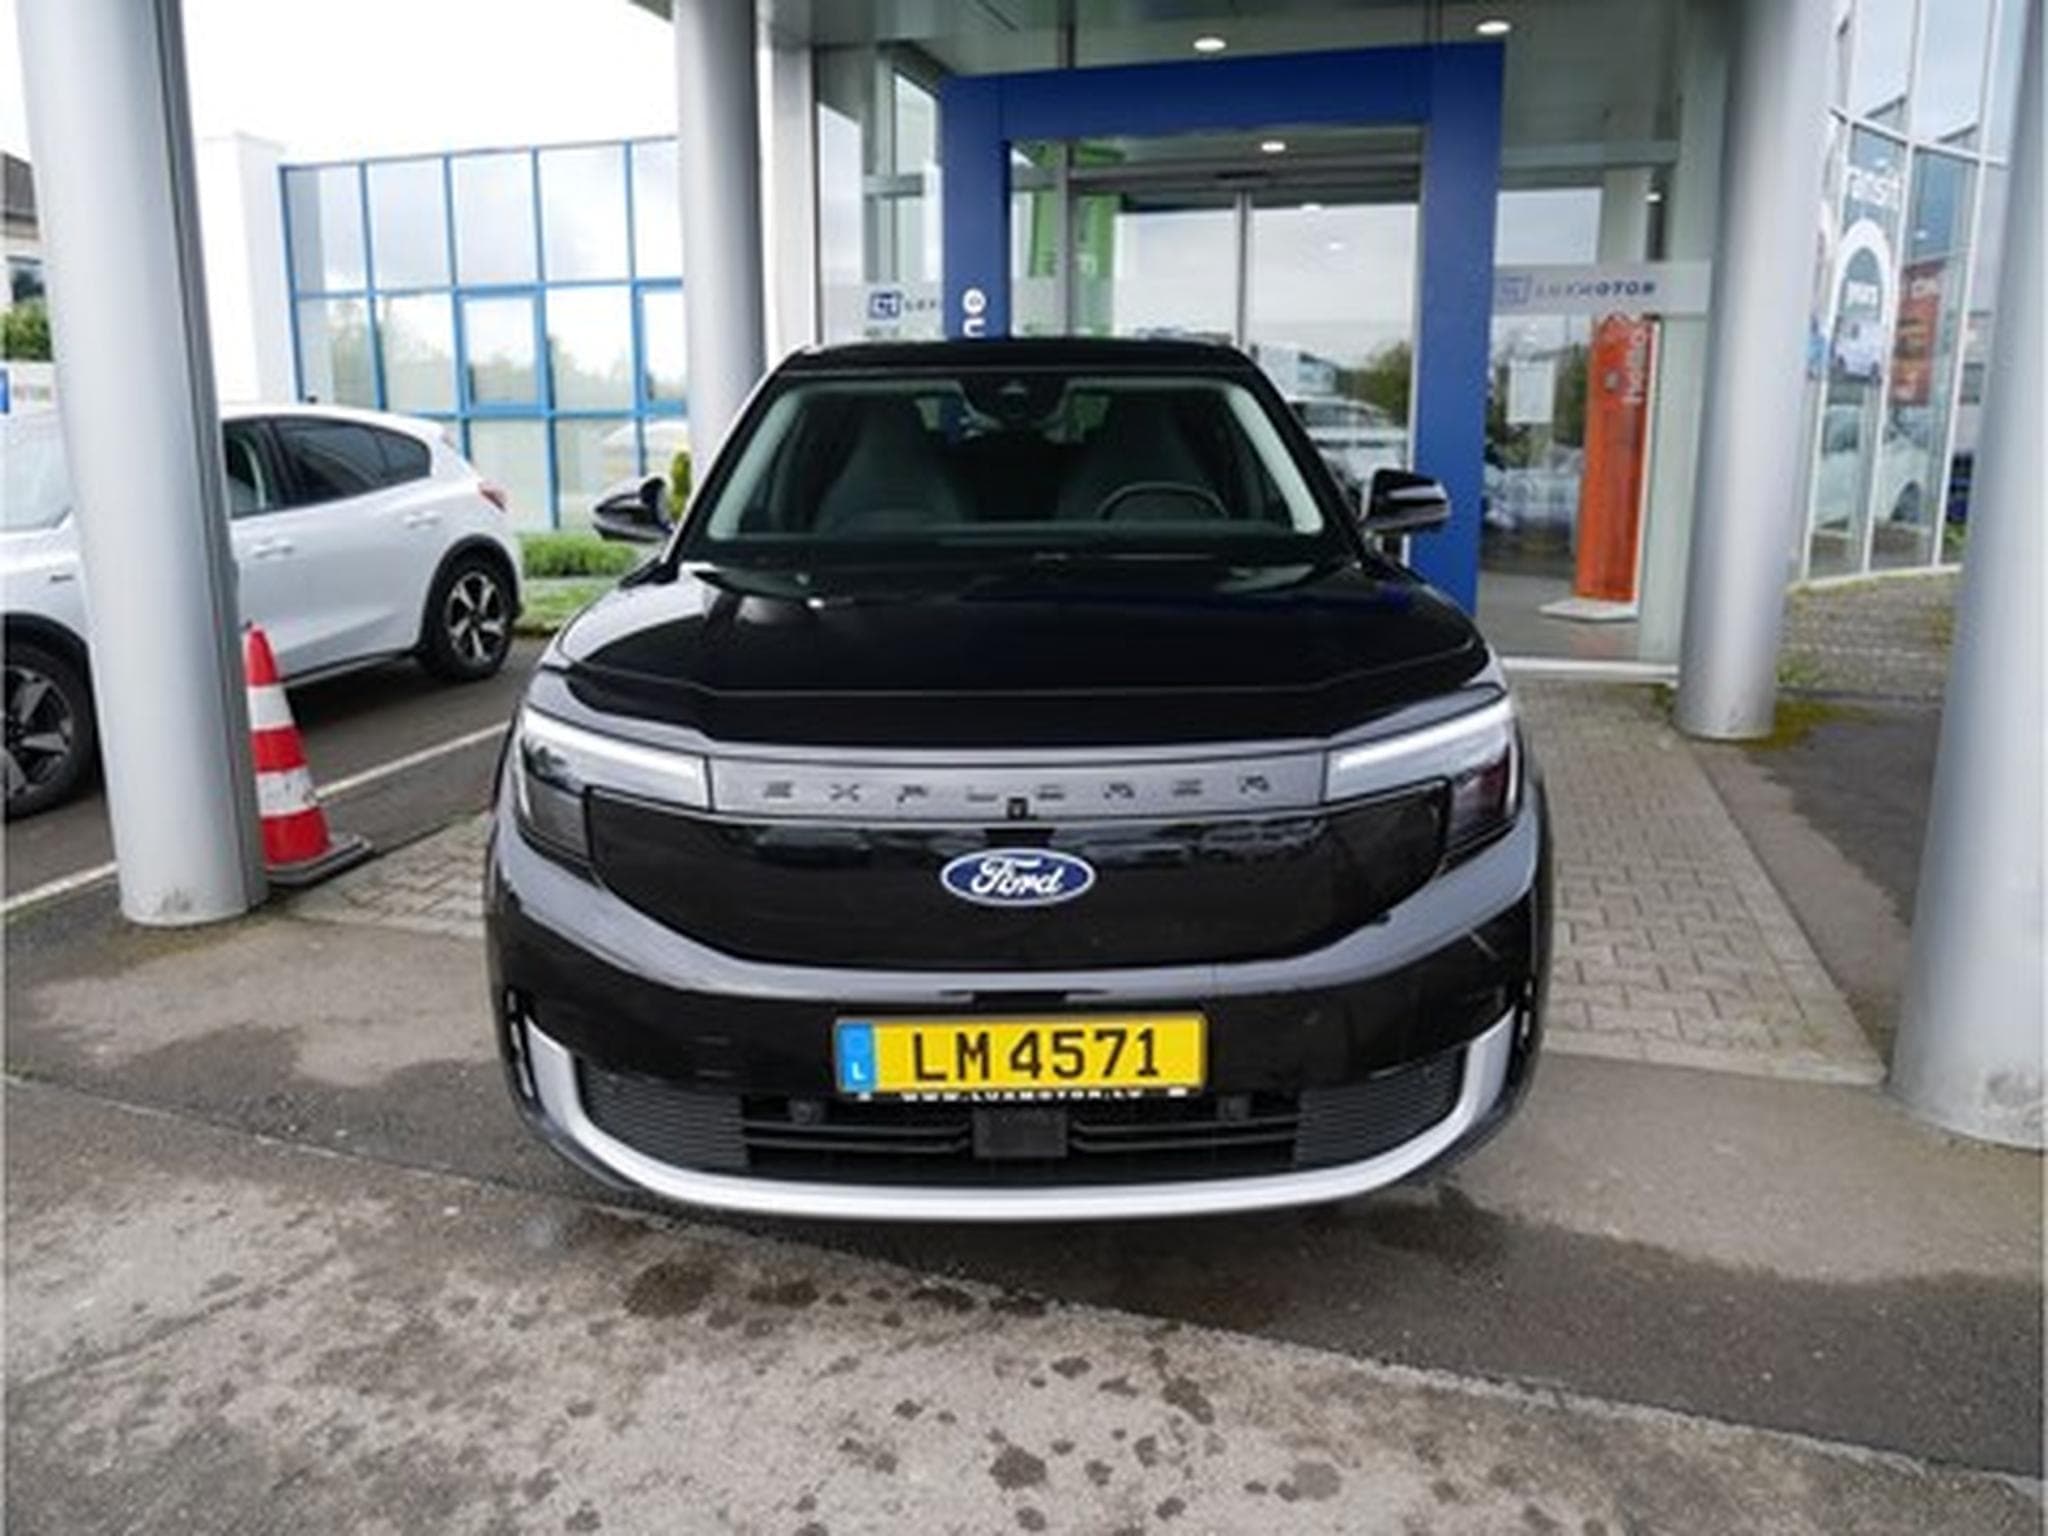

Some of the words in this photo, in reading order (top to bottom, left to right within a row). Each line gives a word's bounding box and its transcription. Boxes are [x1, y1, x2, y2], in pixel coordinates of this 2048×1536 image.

[970, 857, 1066, 896] Ford
[912, 1031, 992, 1081] LM
[1009, 1027, 1160, 1079] 4571
